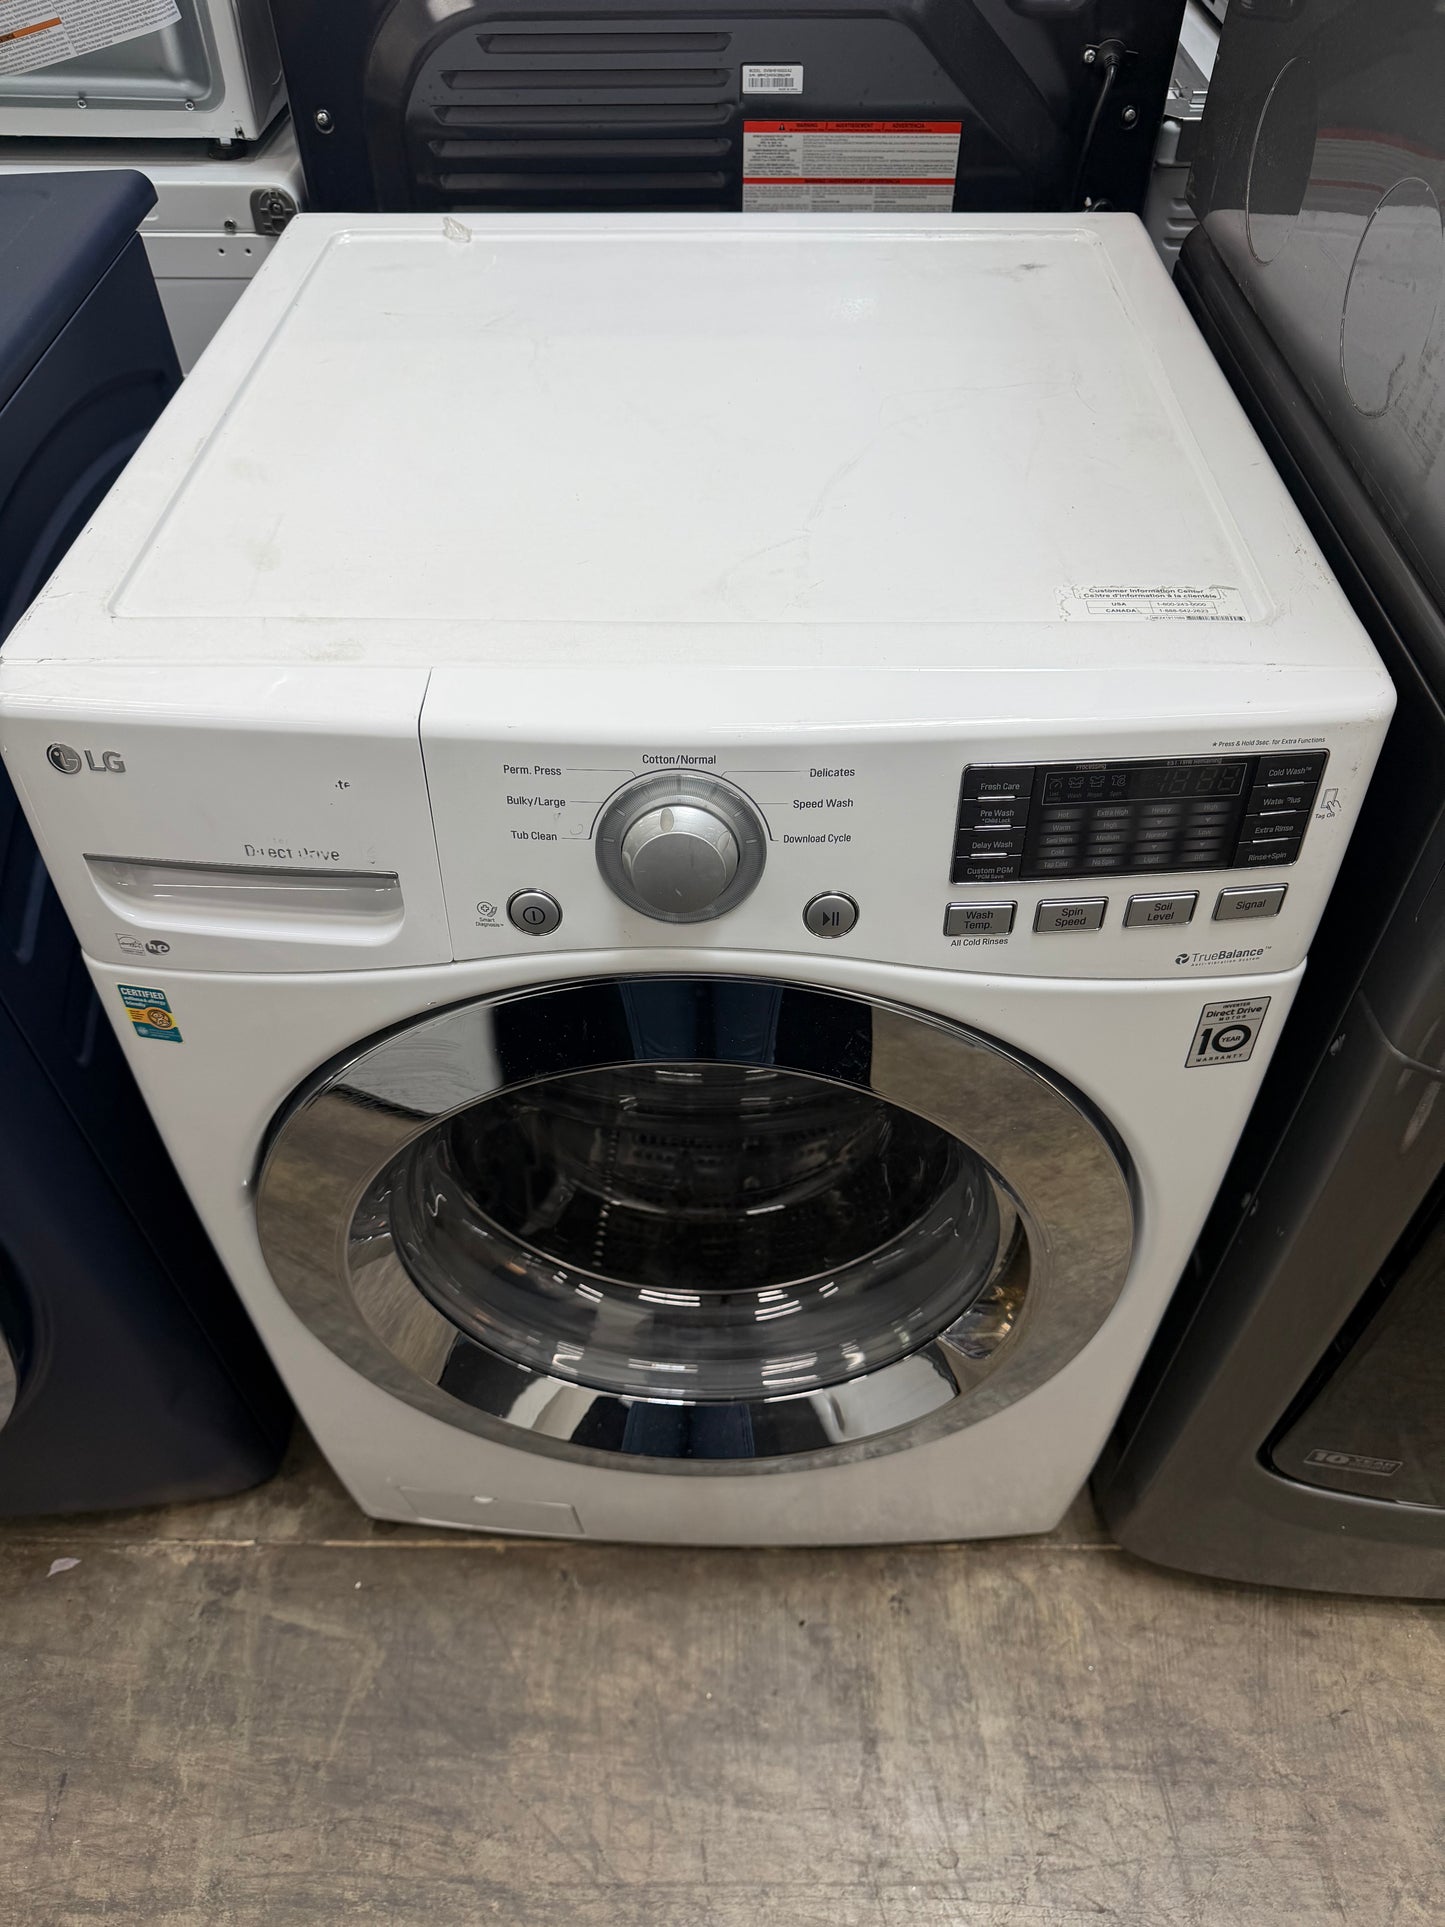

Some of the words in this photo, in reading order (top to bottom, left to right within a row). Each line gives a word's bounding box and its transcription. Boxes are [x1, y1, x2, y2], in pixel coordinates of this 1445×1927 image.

[84, 749, 126, 773] LG
[642, 754, 717, 765] Cotton/Normal
[503, 764, 532, 775] Perm.
[534, 765, 562, 776] Press
[809, 768, 856, 778] Delicates
[1268, 768, 1284, 777] Cold
[980, 782, 1002, 791] Fresh
[1002, 782, 1020, 790] Care
[506, 795, 566, 808] Bulky/Large
[792, 799, 824, 810] Speed
[826, 798, 854, 808] Wash
[1151, 806, 1172, 815] Heavy
[1204, 803, 1218, 811] High
[994, 809, 1015, 817] Wash
[1096, 809, 1114, 817] Extra
[1114, 808, 1129, 816] High
[1145, 830, 1168, 839] Normal
[1254, 826, 1274, 834] Extra
[1274, 825, 1294, 833] Rinse
[510, 830, 529, 840] Tub
[531, 831, 558, 841] Clean
[783, 834, 826, 844] Download
[828, 833, 852, 844] Cycle
[972, 841, 992, 850] Delay
[1143, 856, 1160, 864] Light
[1248, 852, 1288, 862] Rinse+Spin
[967, 867, 995, 875] Custom
[1154, 902, 1173, 912] Soil
[1236, 899, 1267, 911] Signal
[966, 910, 994, 920] Wash
[1061, 907, 1084, 918] Spin
[1147, 912, 1175, 922] Level
[964, 920, 993, 930] Temp.
[1055, 918, 1087, 928] Speed
[950, 939, 962, 948] All
[962, 938, 981, 946] Cold
[982, 937, 1009, 946] Rinses
[120, 987, 165, 1000] CERTIFIED
[1206, 1009, 1236, 1018] Direct
[1236, 1006, 1263, 1015] Drive
[1198, 1024, 1252, 1056] 10
[1221, 1035, 1241, 1043] YEAR
[1195, 1053, 1244, 1063] WARRANTY
[1314, 1452, 1350, 1465] 10
